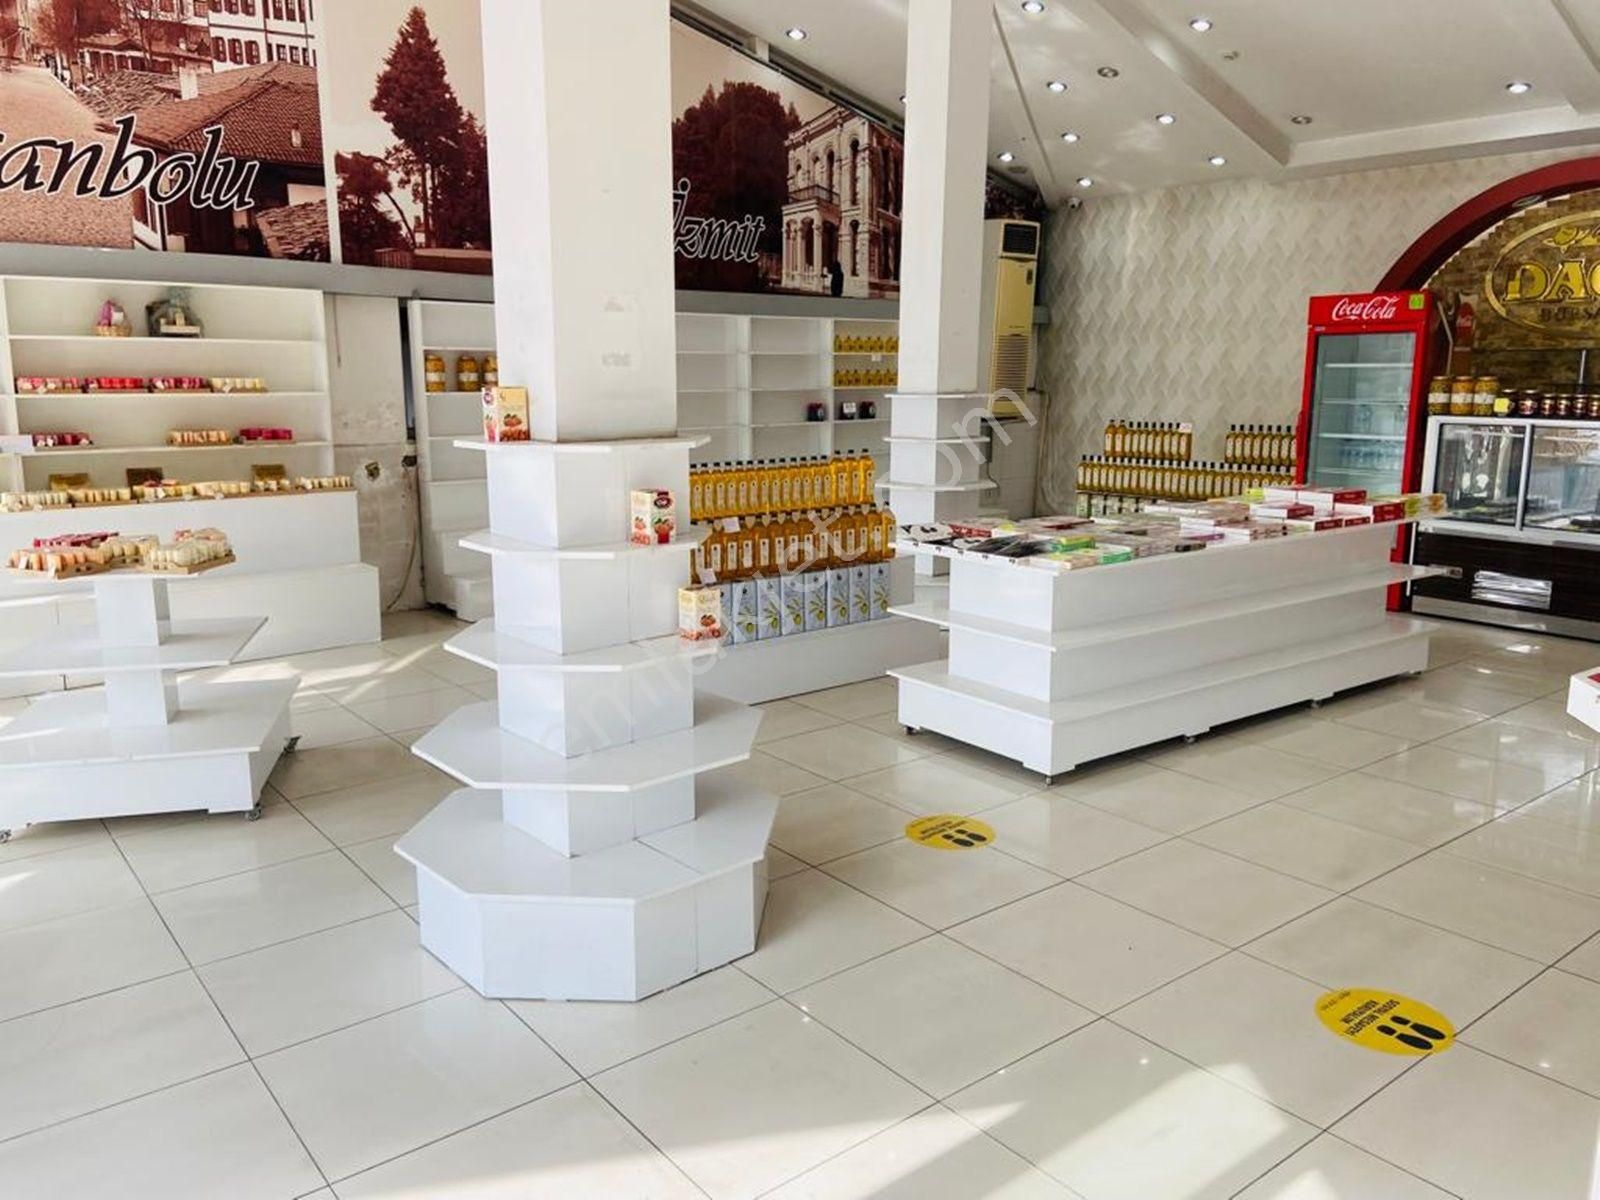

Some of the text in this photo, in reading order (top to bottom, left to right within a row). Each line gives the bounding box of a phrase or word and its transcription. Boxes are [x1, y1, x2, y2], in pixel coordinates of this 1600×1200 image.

[0, 114, 260, 212] anbolu
[1502, 258, 1600, 303] DA
[1331, 295, 1401, 321] Coca-Cola
